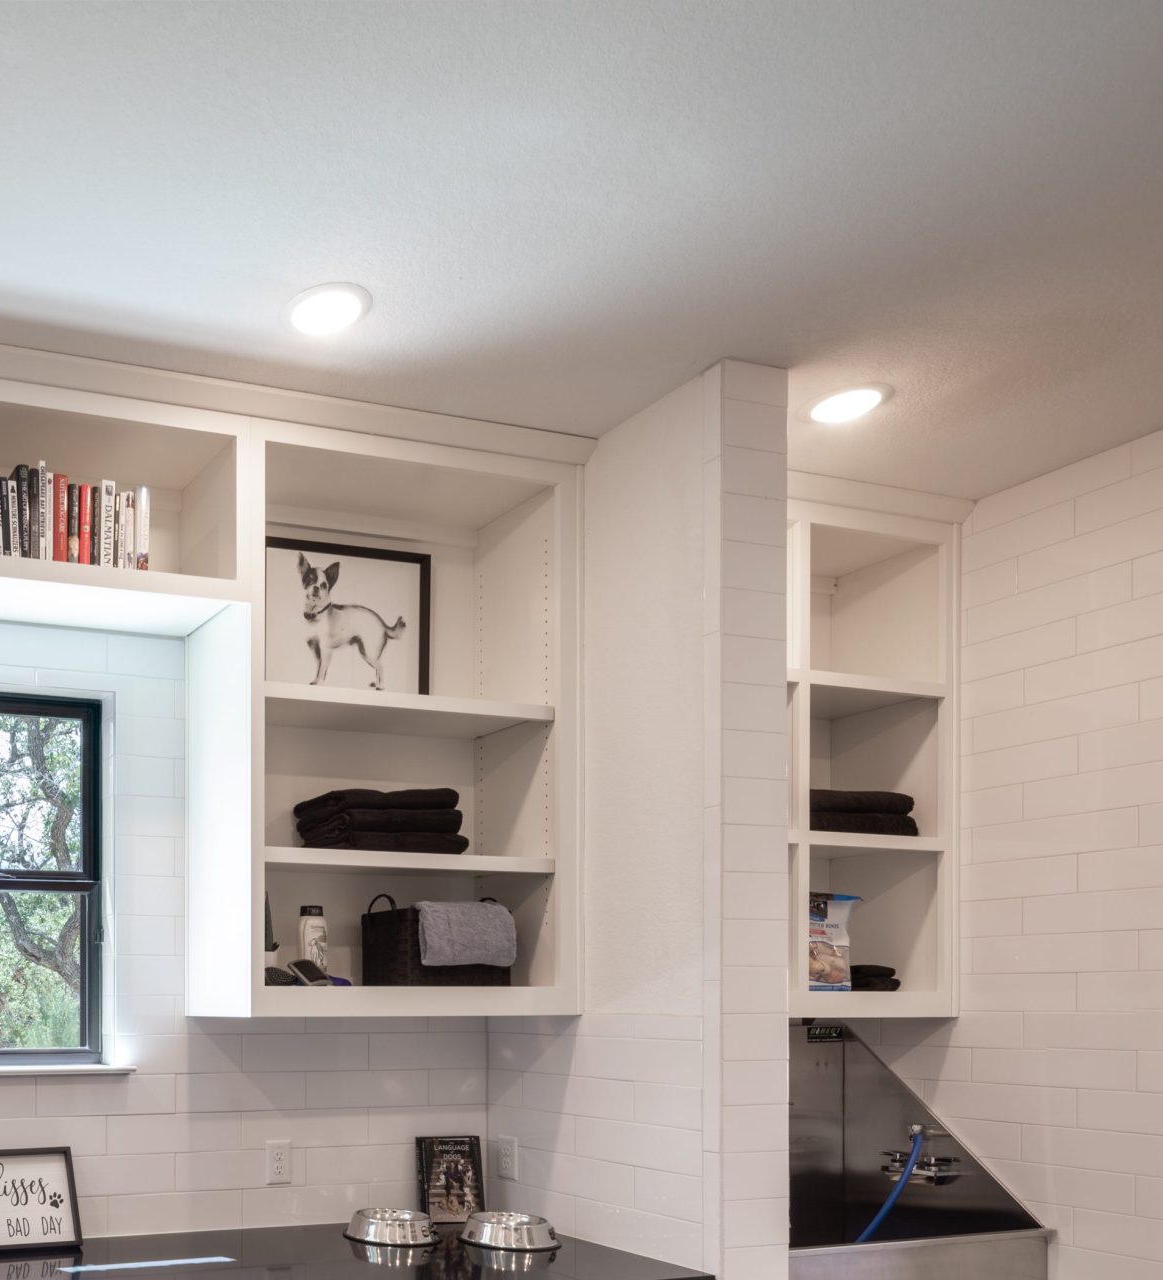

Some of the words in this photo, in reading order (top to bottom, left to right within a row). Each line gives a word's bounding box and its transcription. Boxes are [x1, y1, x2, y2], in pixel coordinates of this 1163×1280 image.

[103, 505, 113, 564] DALMATIAN
[6, 1217, 30, 1238] BAD
[41, 1215, 63, 1236] DAY
